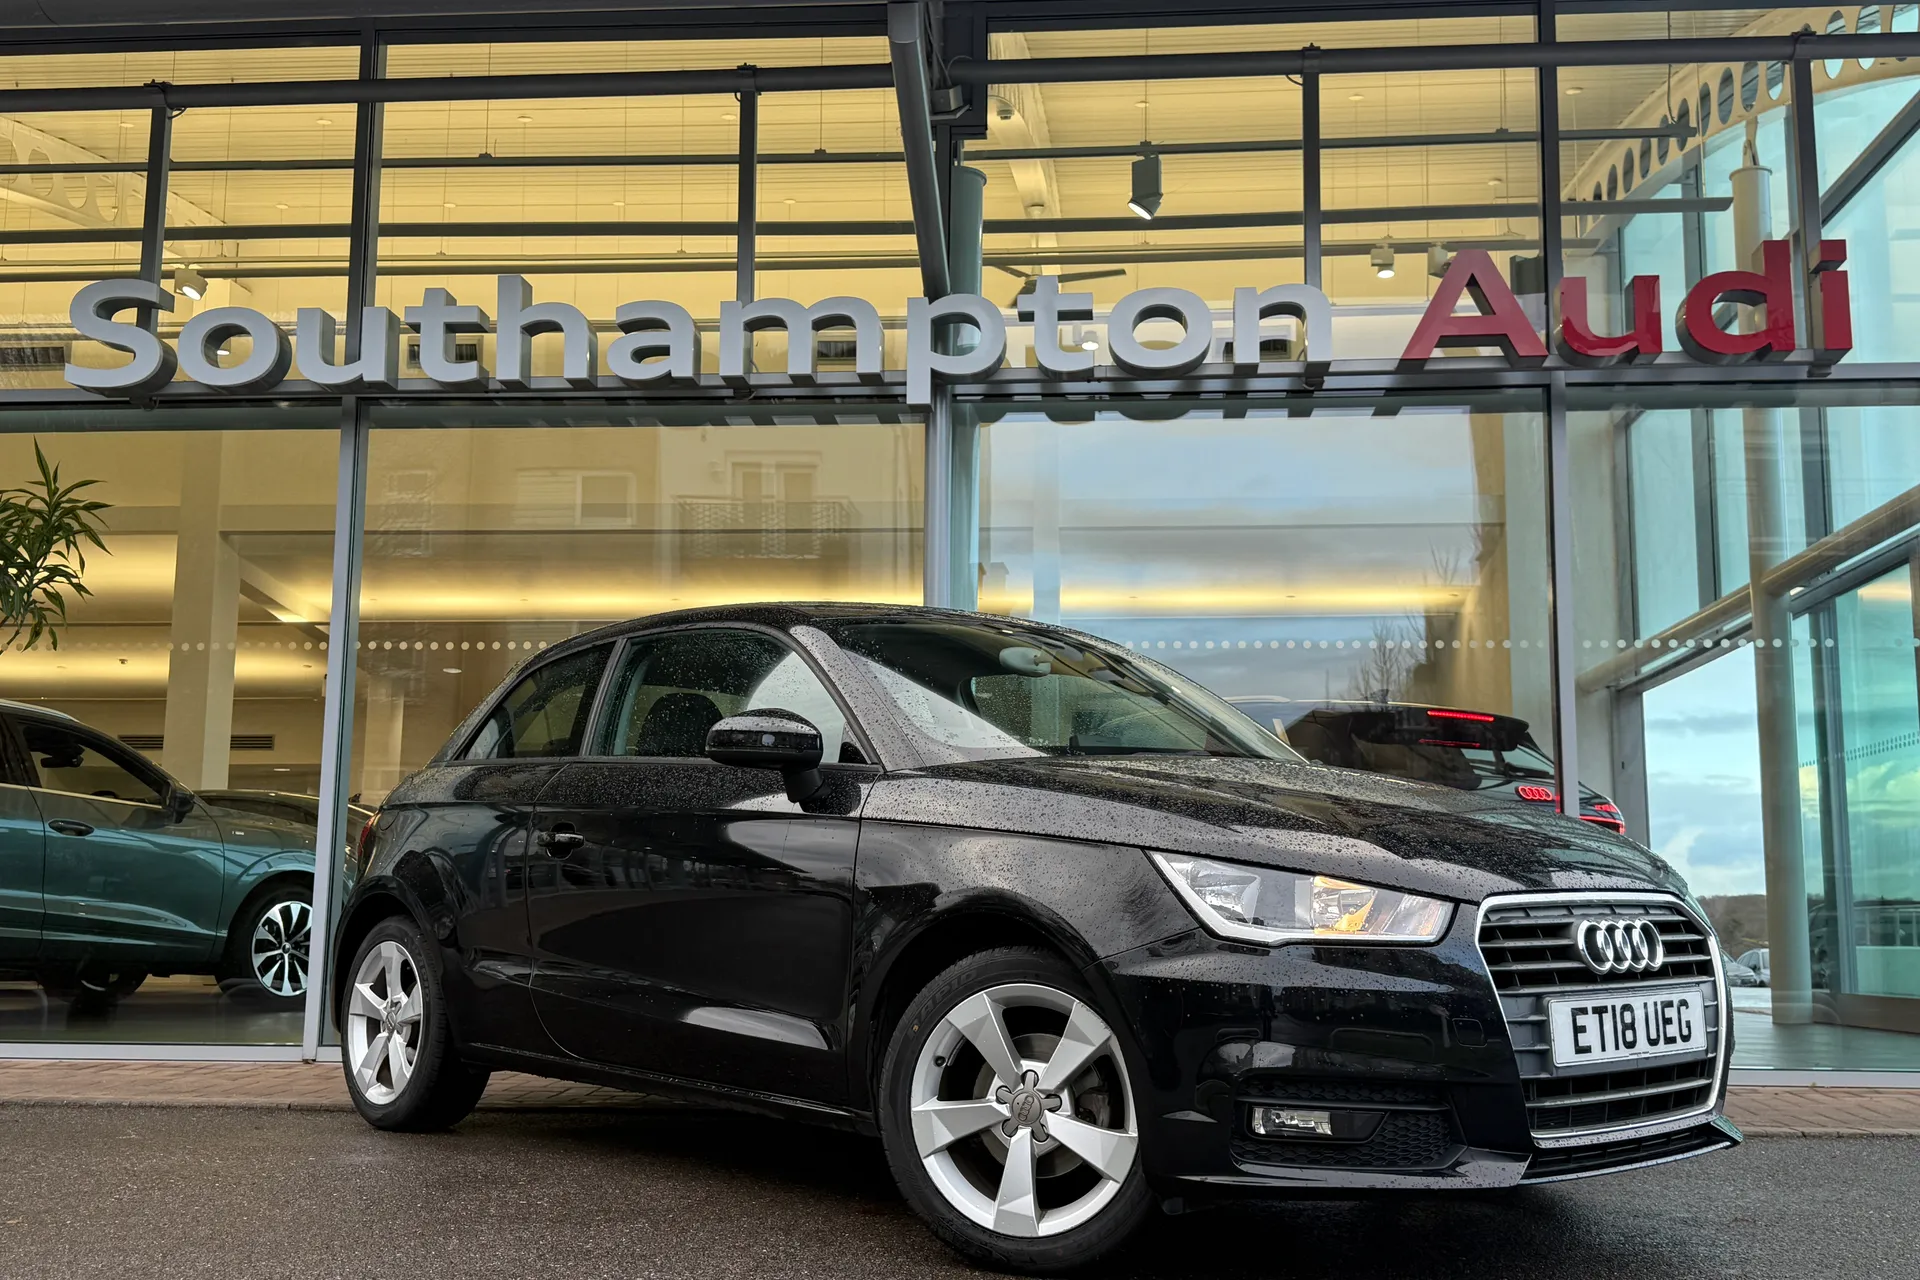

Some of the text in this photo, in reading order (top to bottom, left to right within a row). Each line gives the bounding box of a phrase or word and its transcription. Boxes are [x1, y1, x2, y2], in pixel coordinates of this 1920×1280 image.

[64, 239, 1853, 412] Southampton Audi
[1571, 998, 1692, 1055] ET18 UEG
